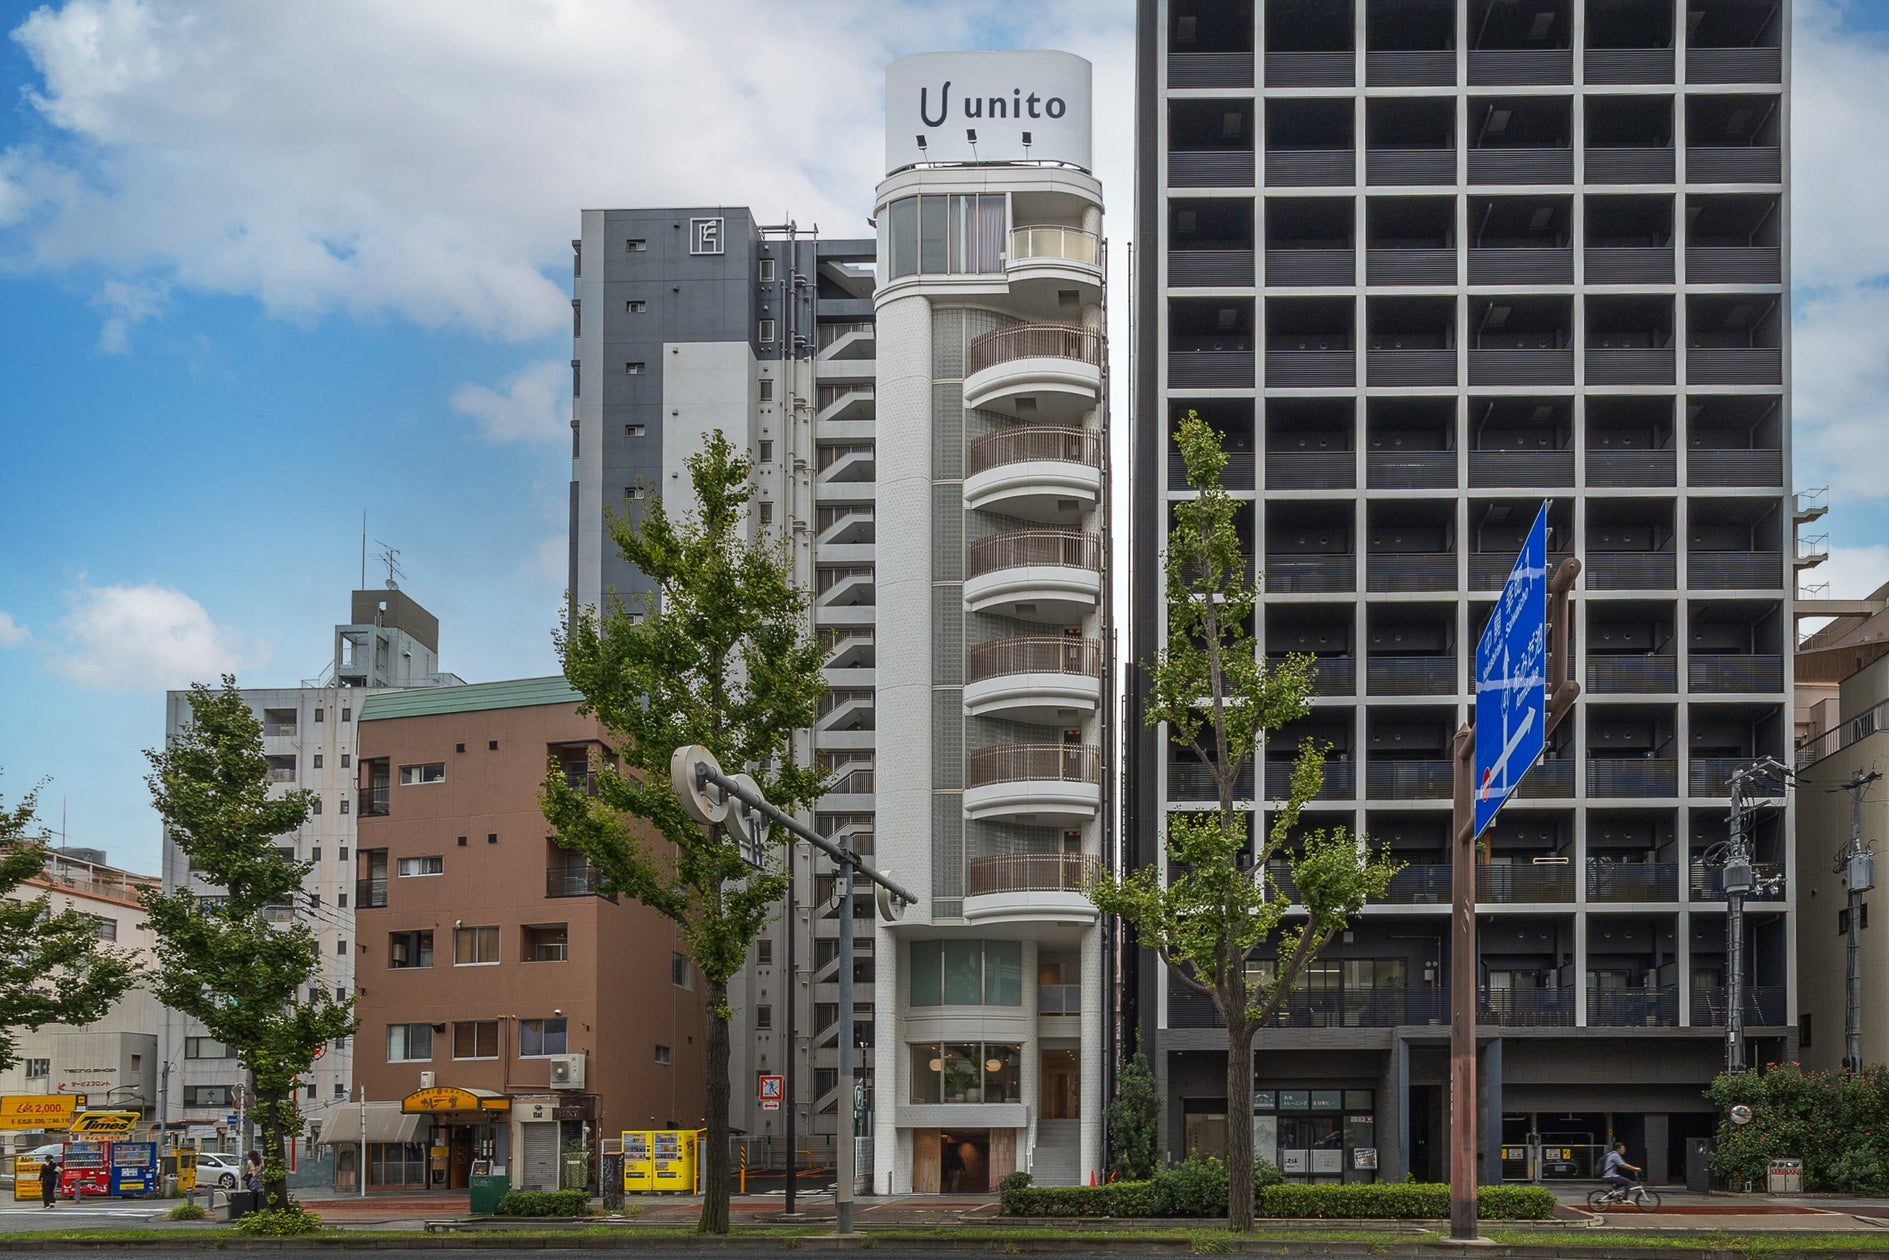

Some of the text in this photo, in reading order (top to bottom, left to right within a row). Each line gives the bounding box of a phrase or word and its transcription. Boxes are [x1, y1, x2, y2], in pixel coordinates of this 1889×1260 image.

[964, 88, 1066, 119] unito
[35, 1104, 61, 1114] 2,000
[83, 1120, 128, 1130] Times
